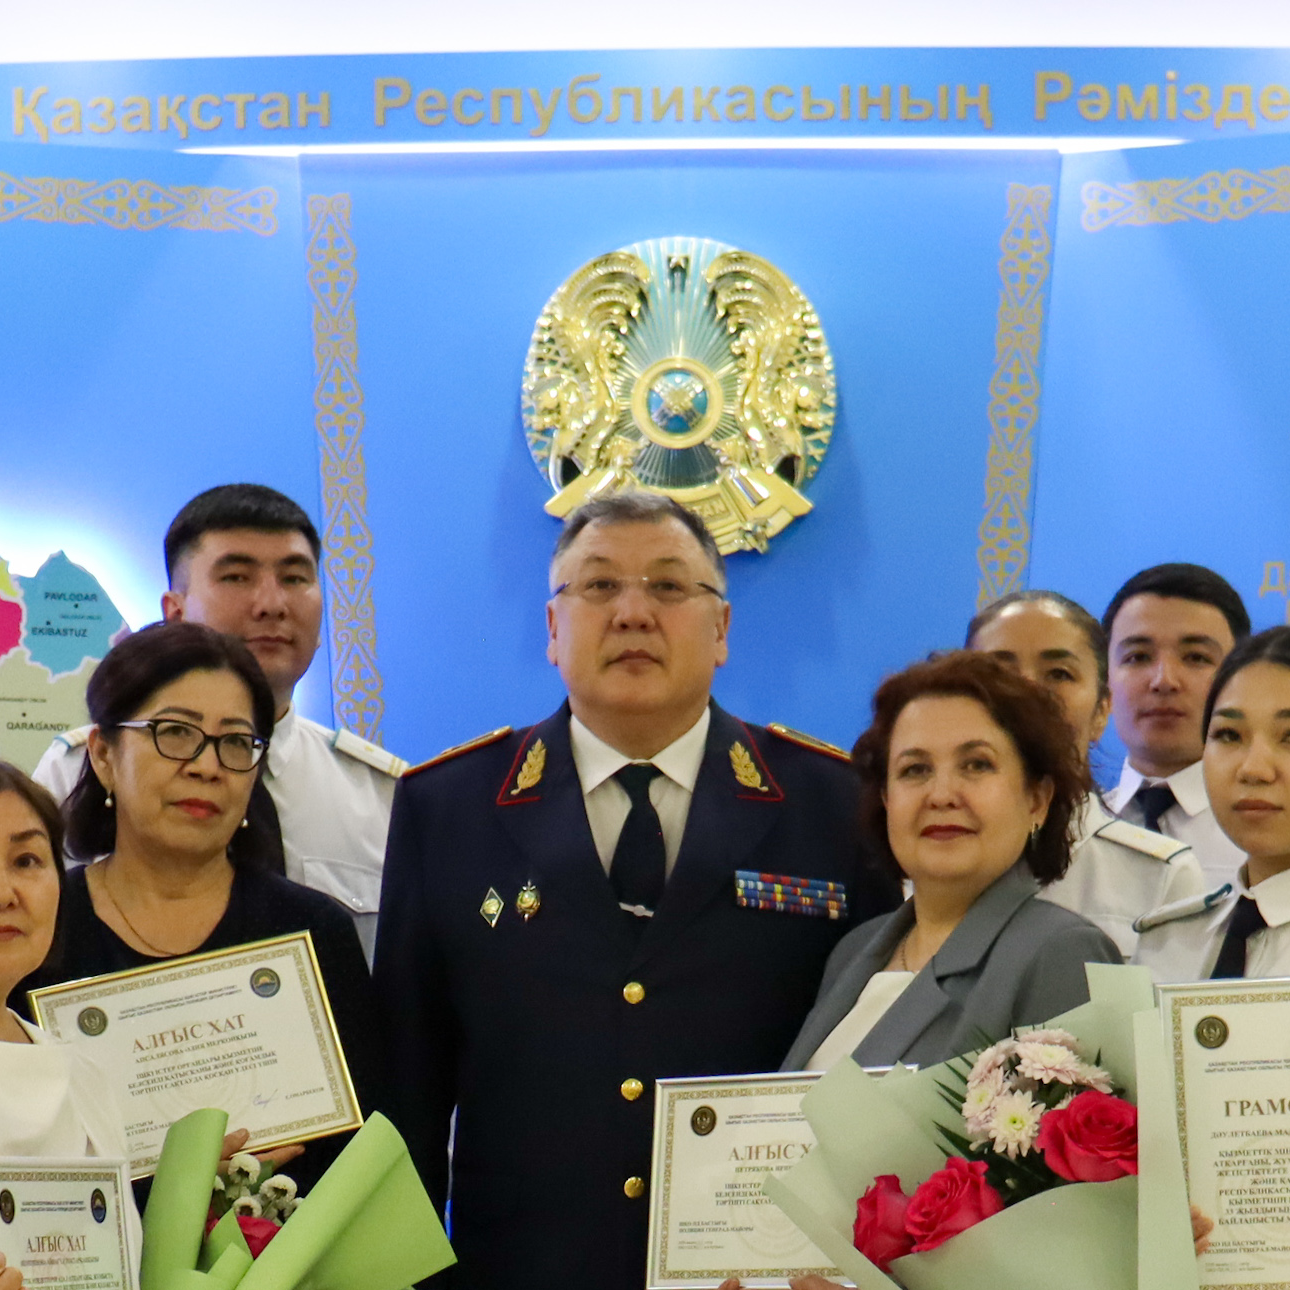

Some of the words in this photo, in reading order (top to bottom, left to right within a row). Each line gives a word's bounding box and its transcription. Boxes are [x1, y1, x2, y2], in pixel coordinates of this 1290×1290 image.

[12, 85, 330, 143] Қазақстан
[373, 73, 994, 137] Республикасының
[44, 592, 98, 602] PAVLODAR
[31, 626, 88, 637] EKIBASTUZ
[133, 1024, 203, 1053] АЛҒЫС
[207, 1014, 245, 1036] ХАТ
[729, 1143, 795, 1161] АЛҒЫС
[27, 1236, 64, 1253] АЛҒЫС
[66, 1235, 87, 1251] ХАТ
